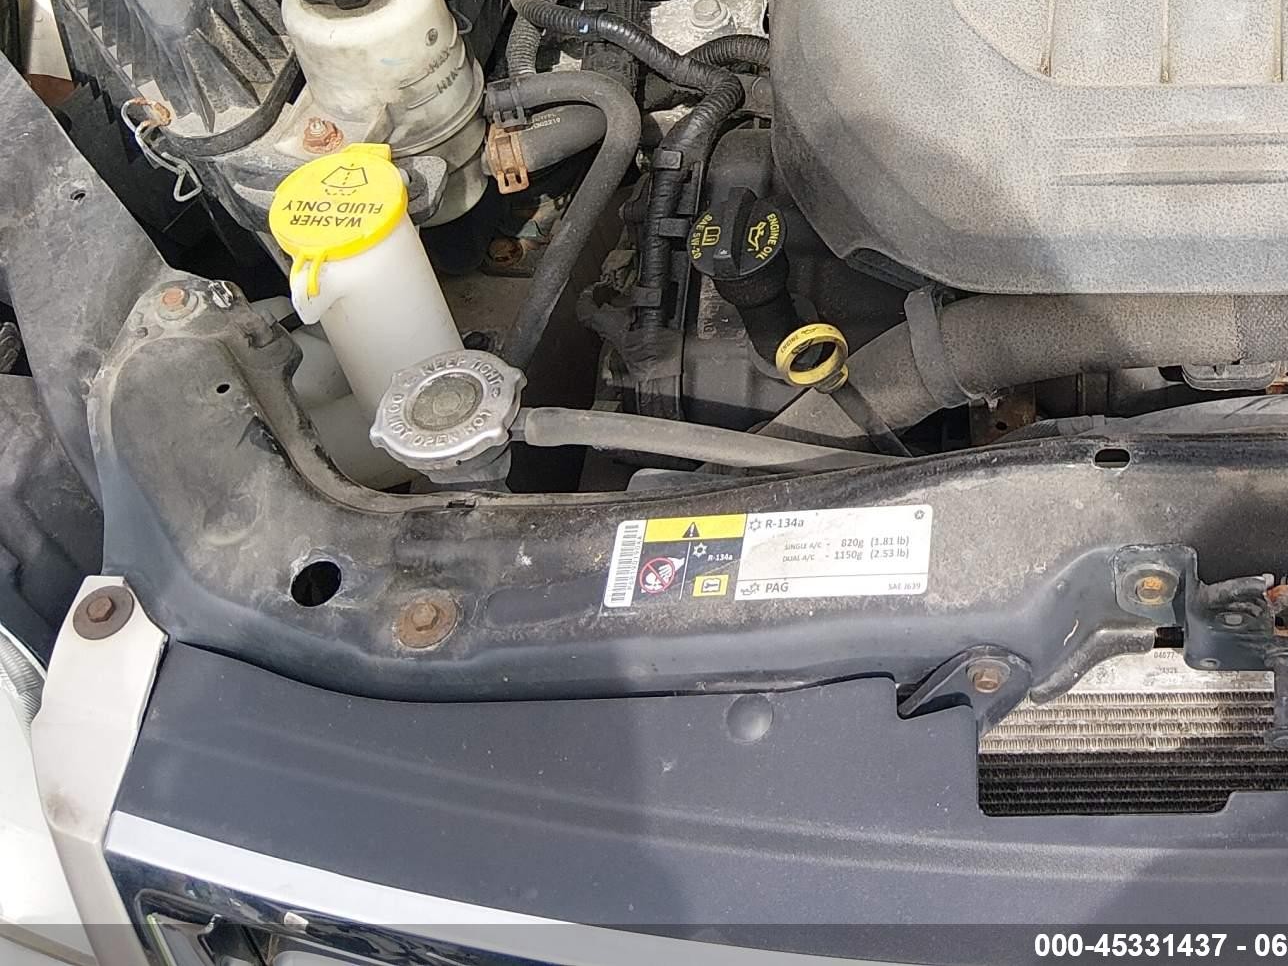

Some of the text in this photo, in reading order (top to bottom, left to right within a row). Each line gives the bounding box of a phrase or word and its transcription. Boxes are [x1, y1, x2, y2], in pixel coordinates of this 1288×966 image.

[282, 200, 384, 214] FLUID ONLY
[289, 214, 362, 228] WASHER
[755, 212, 780, 261] ENGINE OIL
[765, 517, 805, 529] R-134a
[840, 538, 864, 548] 820g
[869, 537, 895, 547] (1.81
[896, 535, 910, 547] lb)
[707, 552, 734, 562] R-134a
[834, 550, 863, 560] 1150g
[869, 549, 894, 560] (2.53
[895, 548, 910, 559] lb)
[765, 581, 790, 594] PAG
